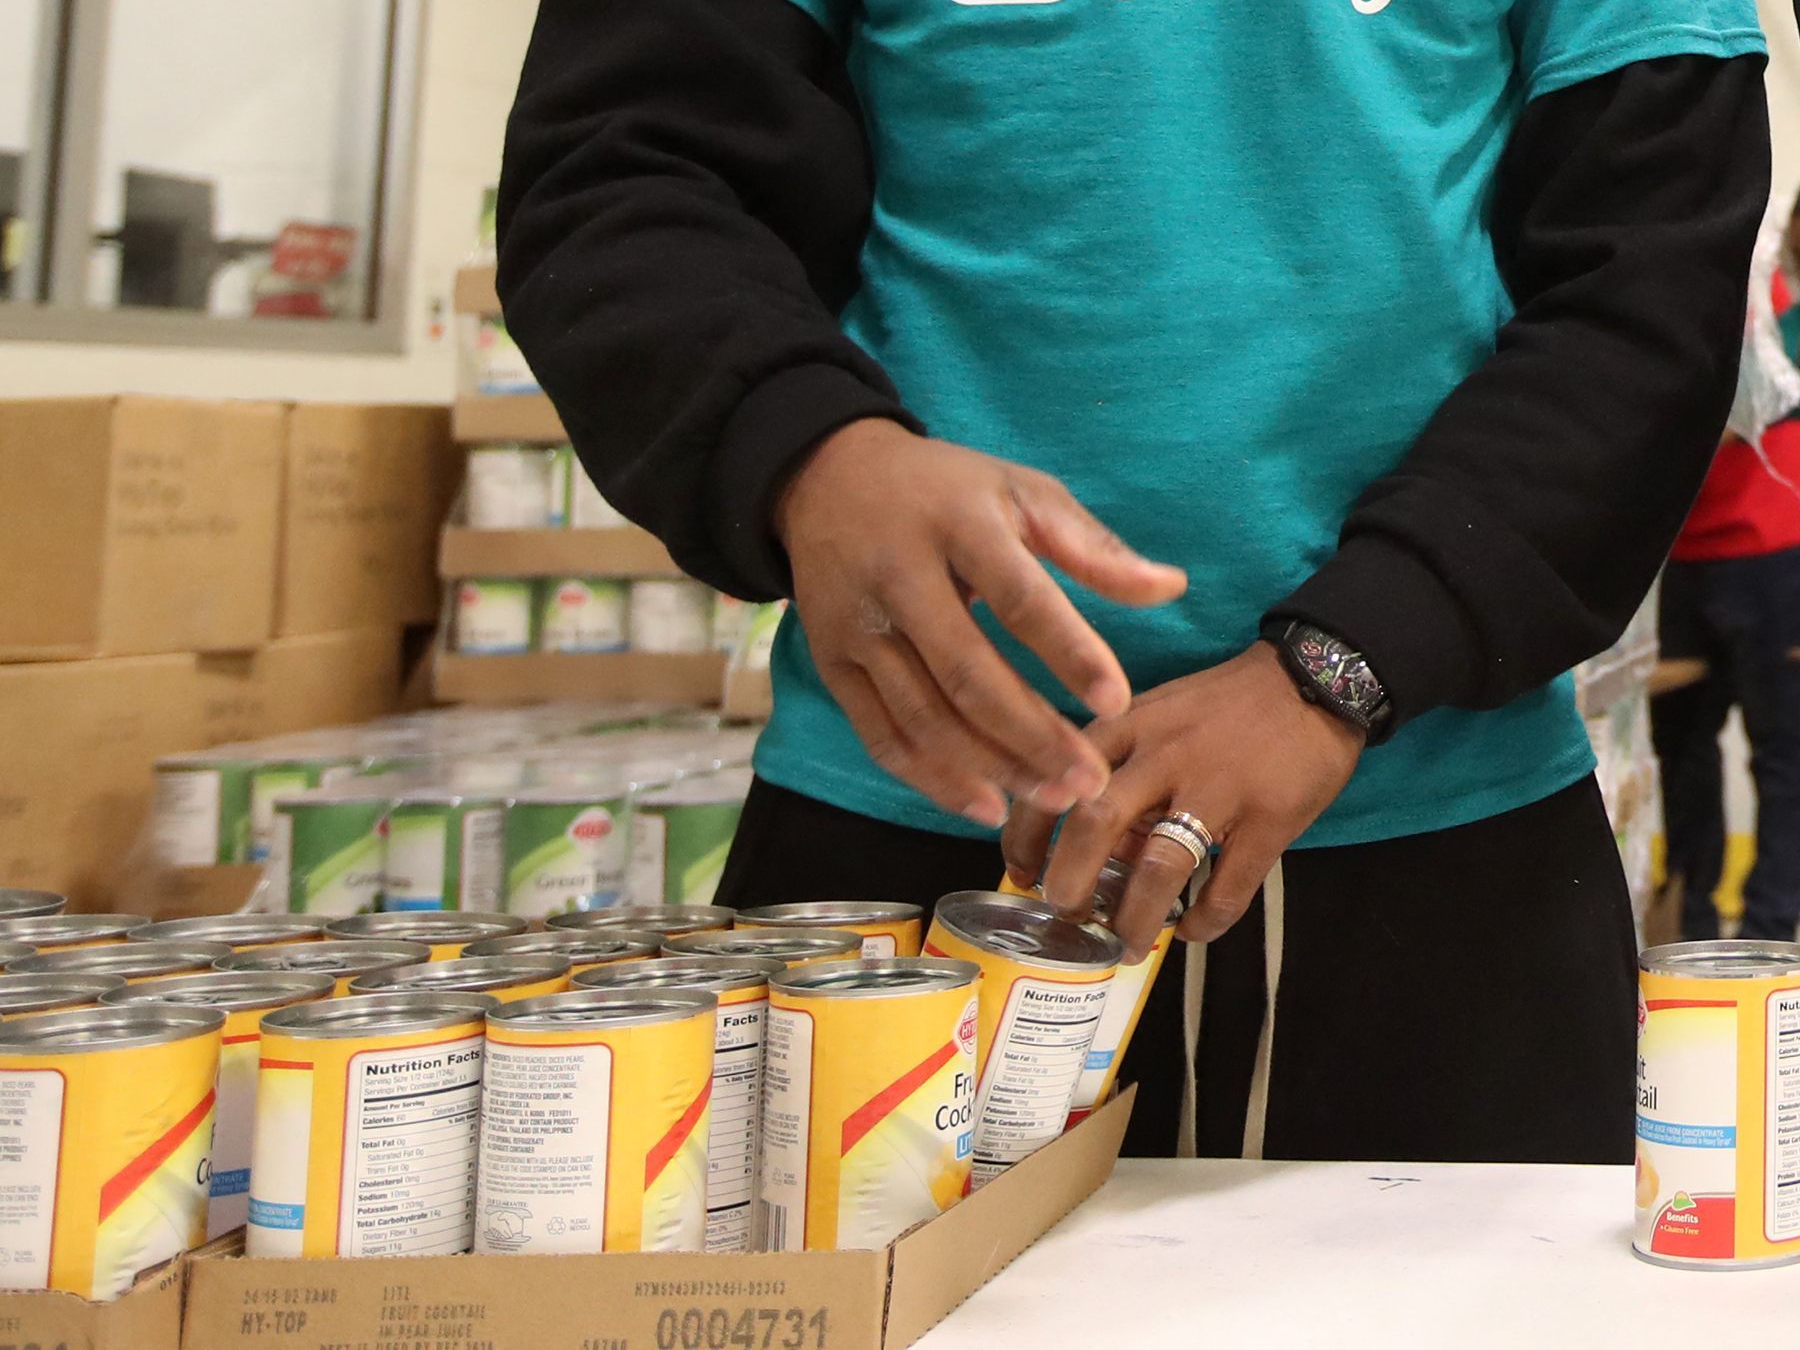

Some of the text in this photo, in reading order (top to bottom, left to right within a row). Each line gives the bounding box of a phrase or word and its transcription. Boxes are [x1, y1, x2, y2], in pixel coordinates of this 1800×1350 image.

[1024, 990, 1081, 1004] Nutrition
[723, 1013, 758, 1028] Facts
[366, 1050, 480, 1076] Nutrition Facts
[362, 1115, 394, 1125] Calories
[361, 1140, 380, 1149] Total
[382, 1139, 395, 1148] Fat
[359, 1177, 403, 1188] Cholesterol
[358, 1192, 388, 1202] Sodium
[357, 1204, 398, 1215] Potassium
[1666, 1211, 1699, 1224] Benefits
[357, 1219, 376, 1228] Total
[655, 1306, 830, 1350] 0004731
